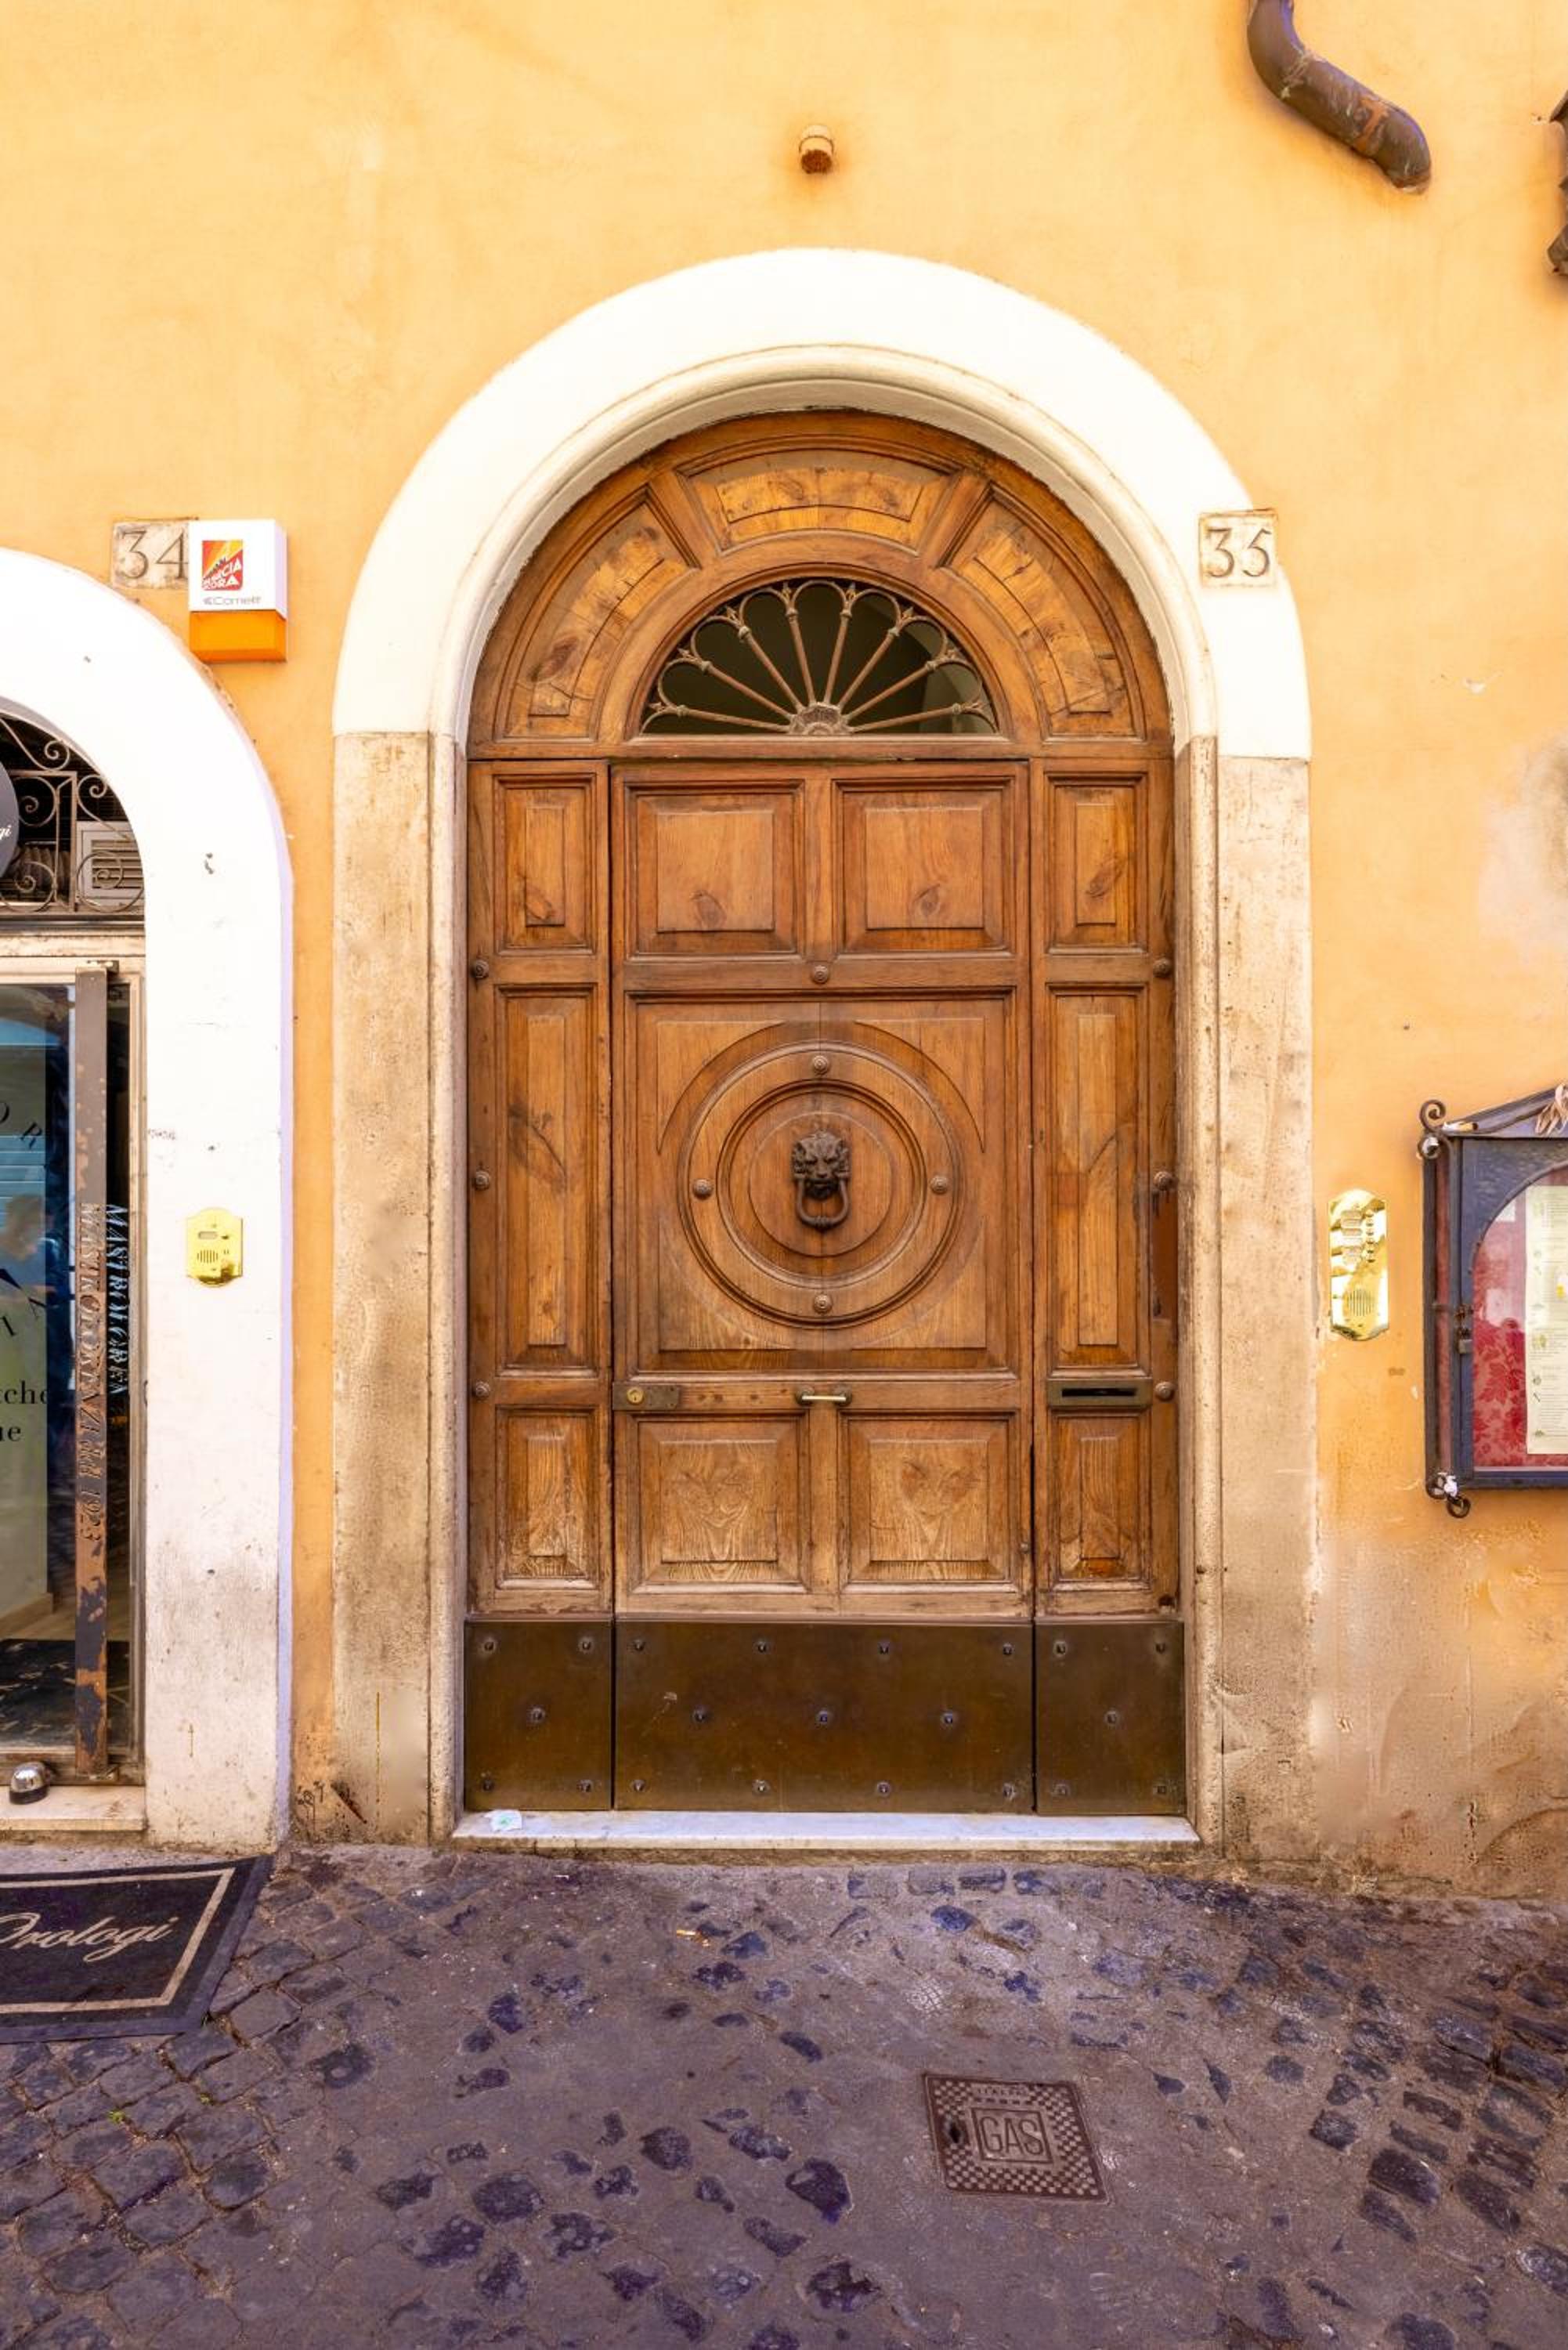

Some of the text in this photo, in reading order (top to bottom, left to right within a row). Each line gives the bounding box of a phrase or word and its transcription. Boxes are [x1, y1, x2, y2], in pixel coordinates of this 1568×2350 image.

[122, 529, 189, 580] 34
[1205, 527, 1273, 578] 33
[979, 2116, 1044, 2156] GAS
